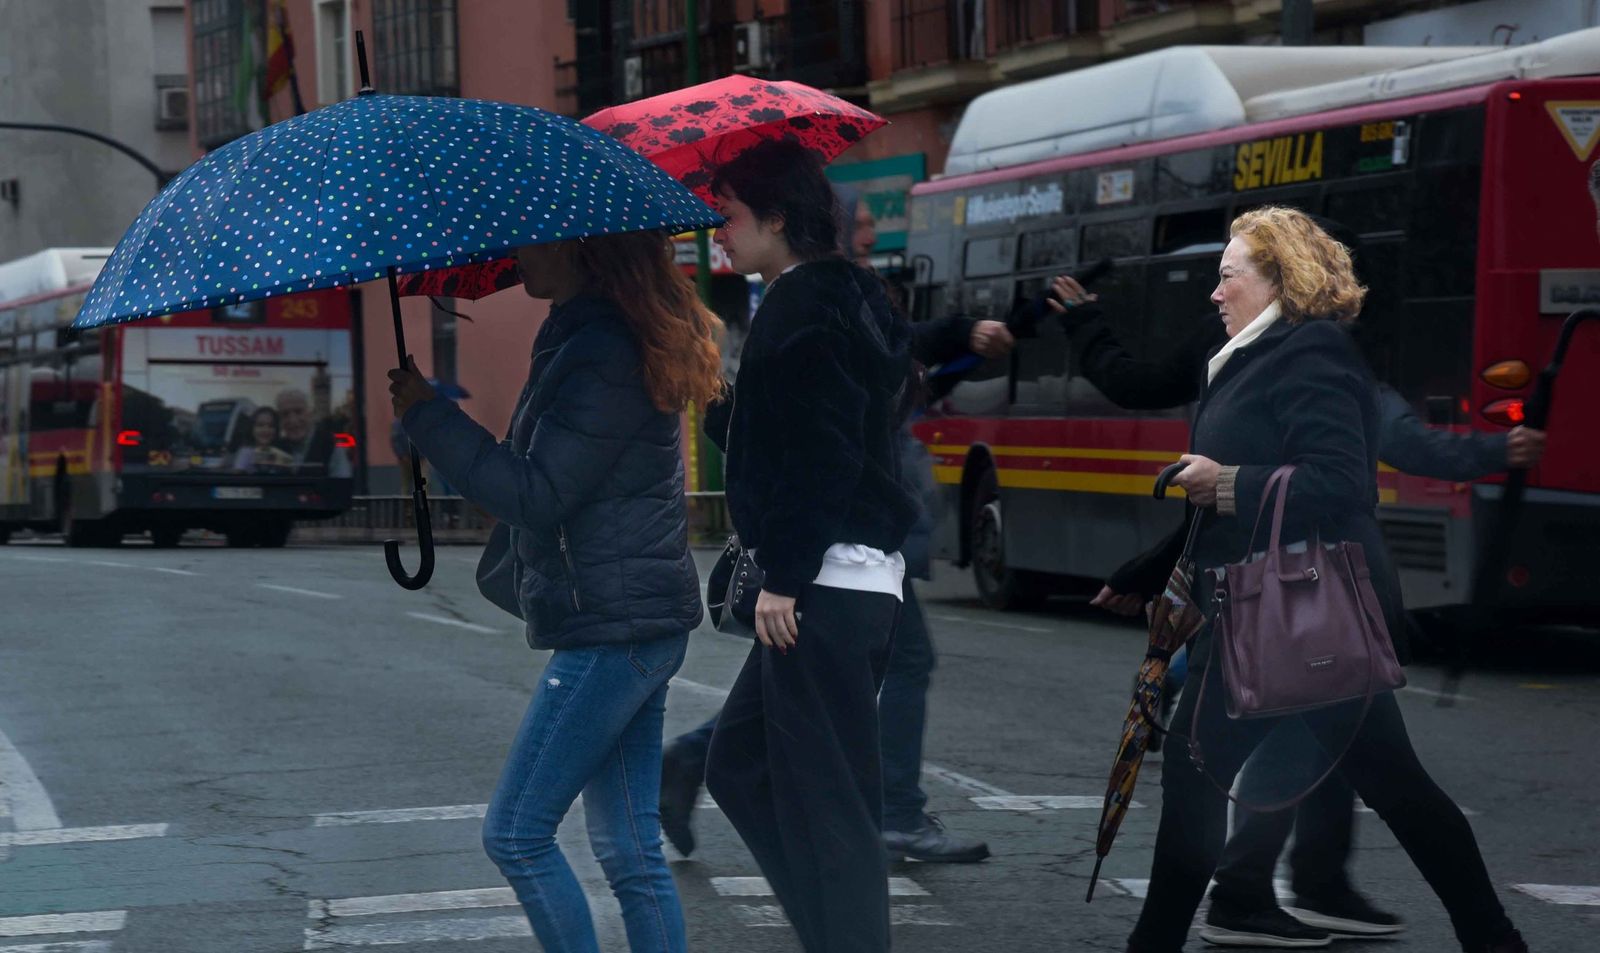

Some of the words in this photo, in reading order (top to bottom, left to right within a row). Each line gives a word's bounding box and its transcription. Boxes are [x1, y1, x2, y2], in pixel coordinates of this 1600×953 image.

[1234, 131, 1324, 192] SEVILLA
[281, 298, 319, 319] 243
[196, 335, 285, 355] TUSSAM
